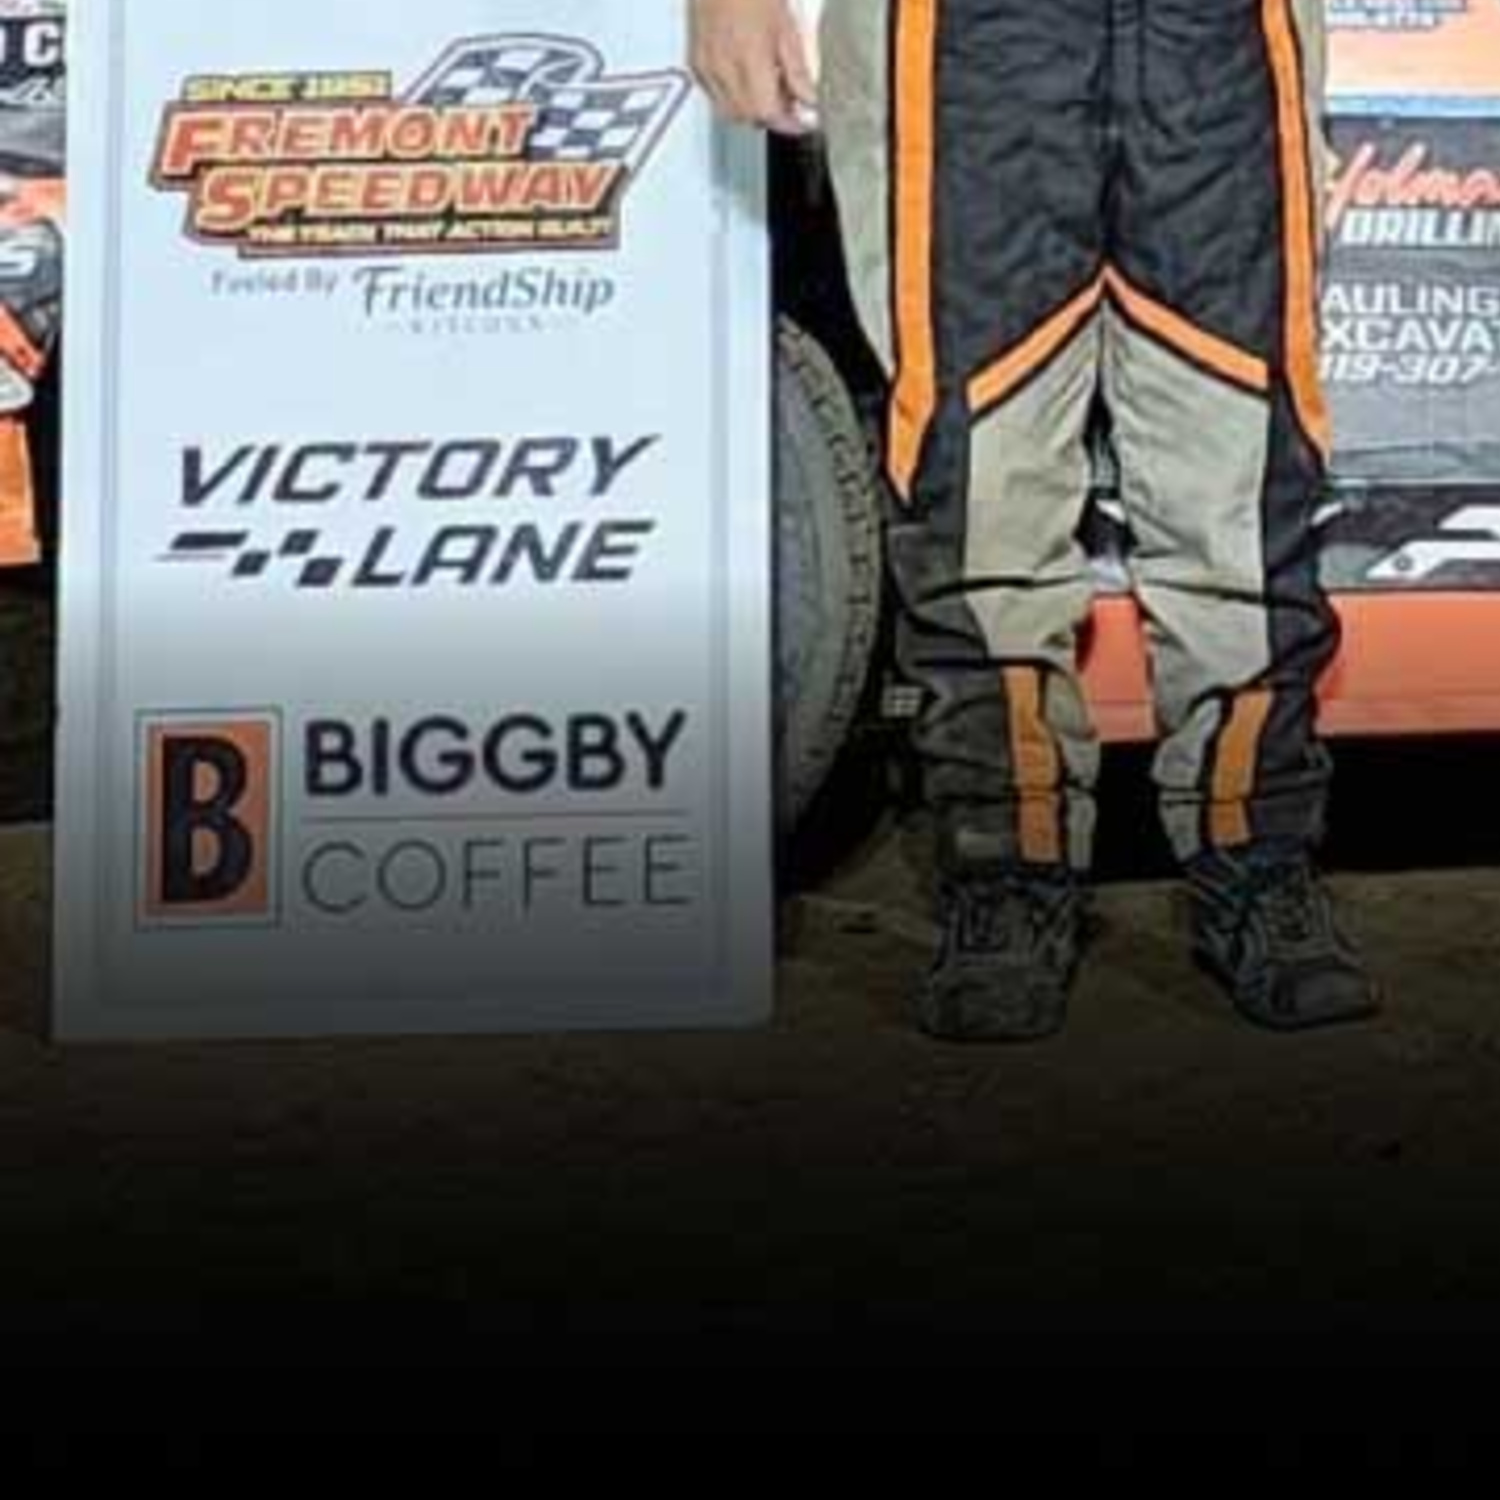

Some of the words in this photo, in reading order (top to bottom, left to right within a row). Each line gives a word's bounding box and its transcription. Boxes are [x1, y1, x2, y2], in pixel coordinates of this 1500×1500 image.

[162, 107, 533, 175] FREMONT
[197, 162, 621, 230] SPEEDWAY
[353, 265, 615, 316] FriendShip
[1321, 284, 1500, 316] AULING
[181, 434, 660, 506] VICTORY
[351, 520, 657, 588] LANE
[302, 711, 687, 797] BIGGBY
[161, 735, 255, 902] B
[301, 835, 692, 915] COFFEE
